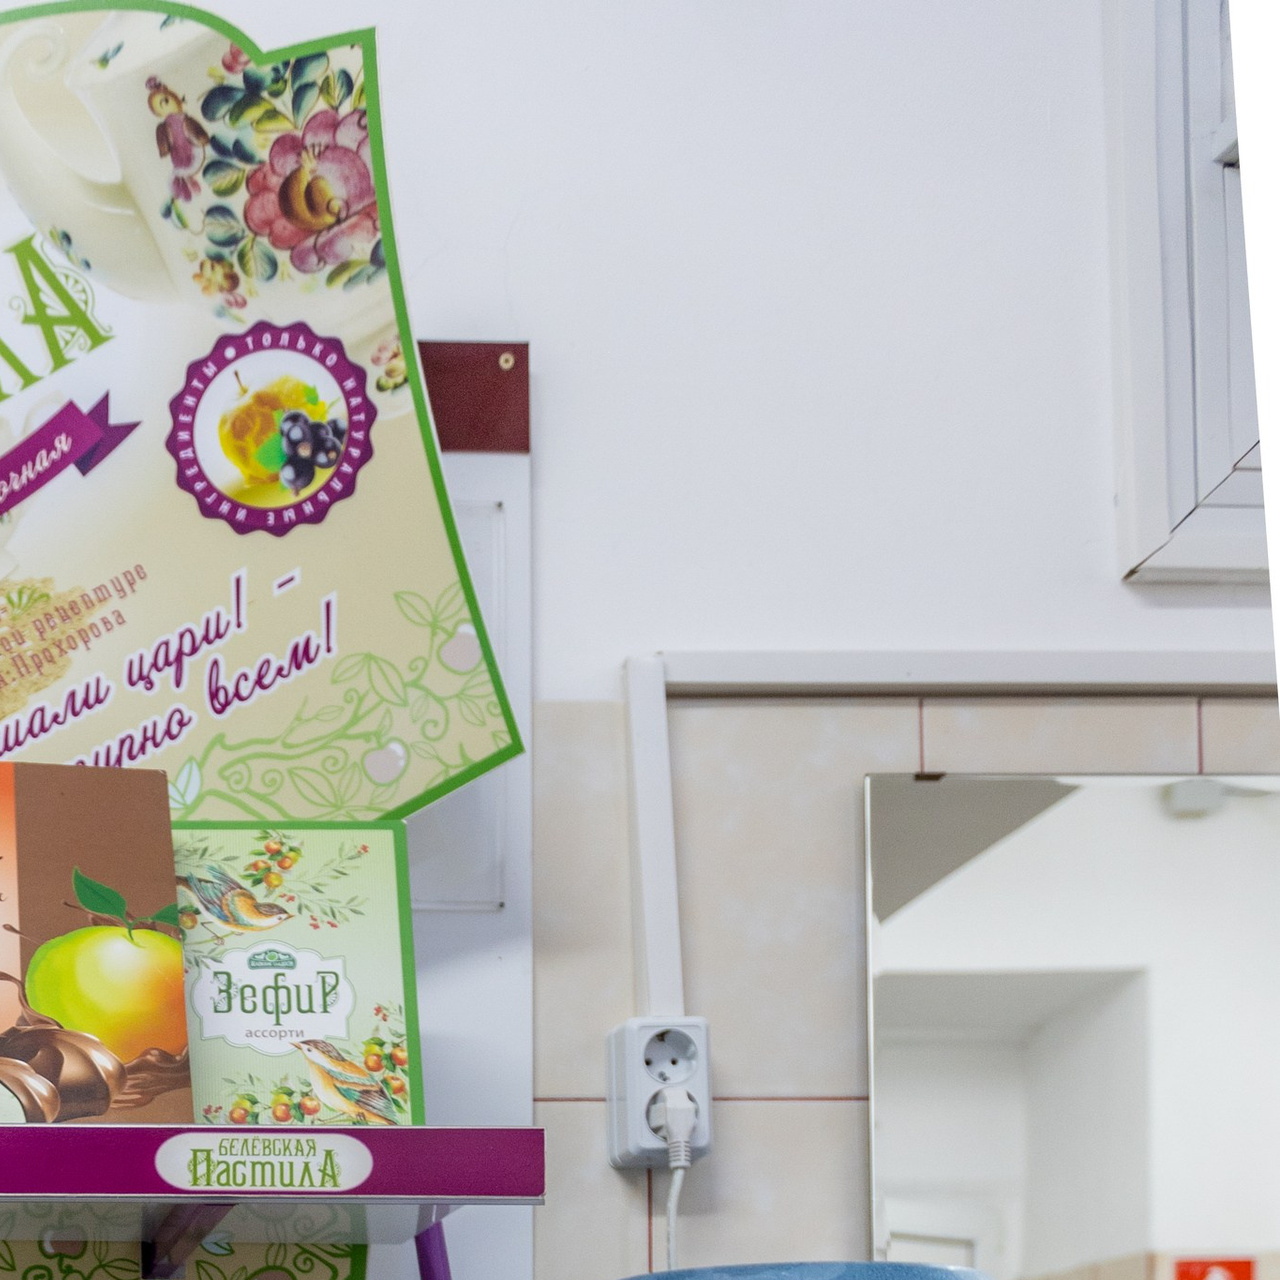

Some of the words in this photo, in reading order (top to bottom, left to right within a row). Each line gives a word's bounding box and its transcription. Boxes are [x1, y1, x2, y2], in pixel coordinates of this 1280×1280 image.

[245, 331, 338, 367] ТОЛЬКО
[177, 361, 247, 523] ИНГРЕДИЕНТЫ
[267, 376, 366, 526] НАТУРАЛЬНЫЕ
[126, 573, 248, 692] цари!
[207, 598, 334, 715] всем!
[244, 1027, 305, 1040] ассорти
[218, 1134, 317, 1159] БЕЛЁВСКАЯ
